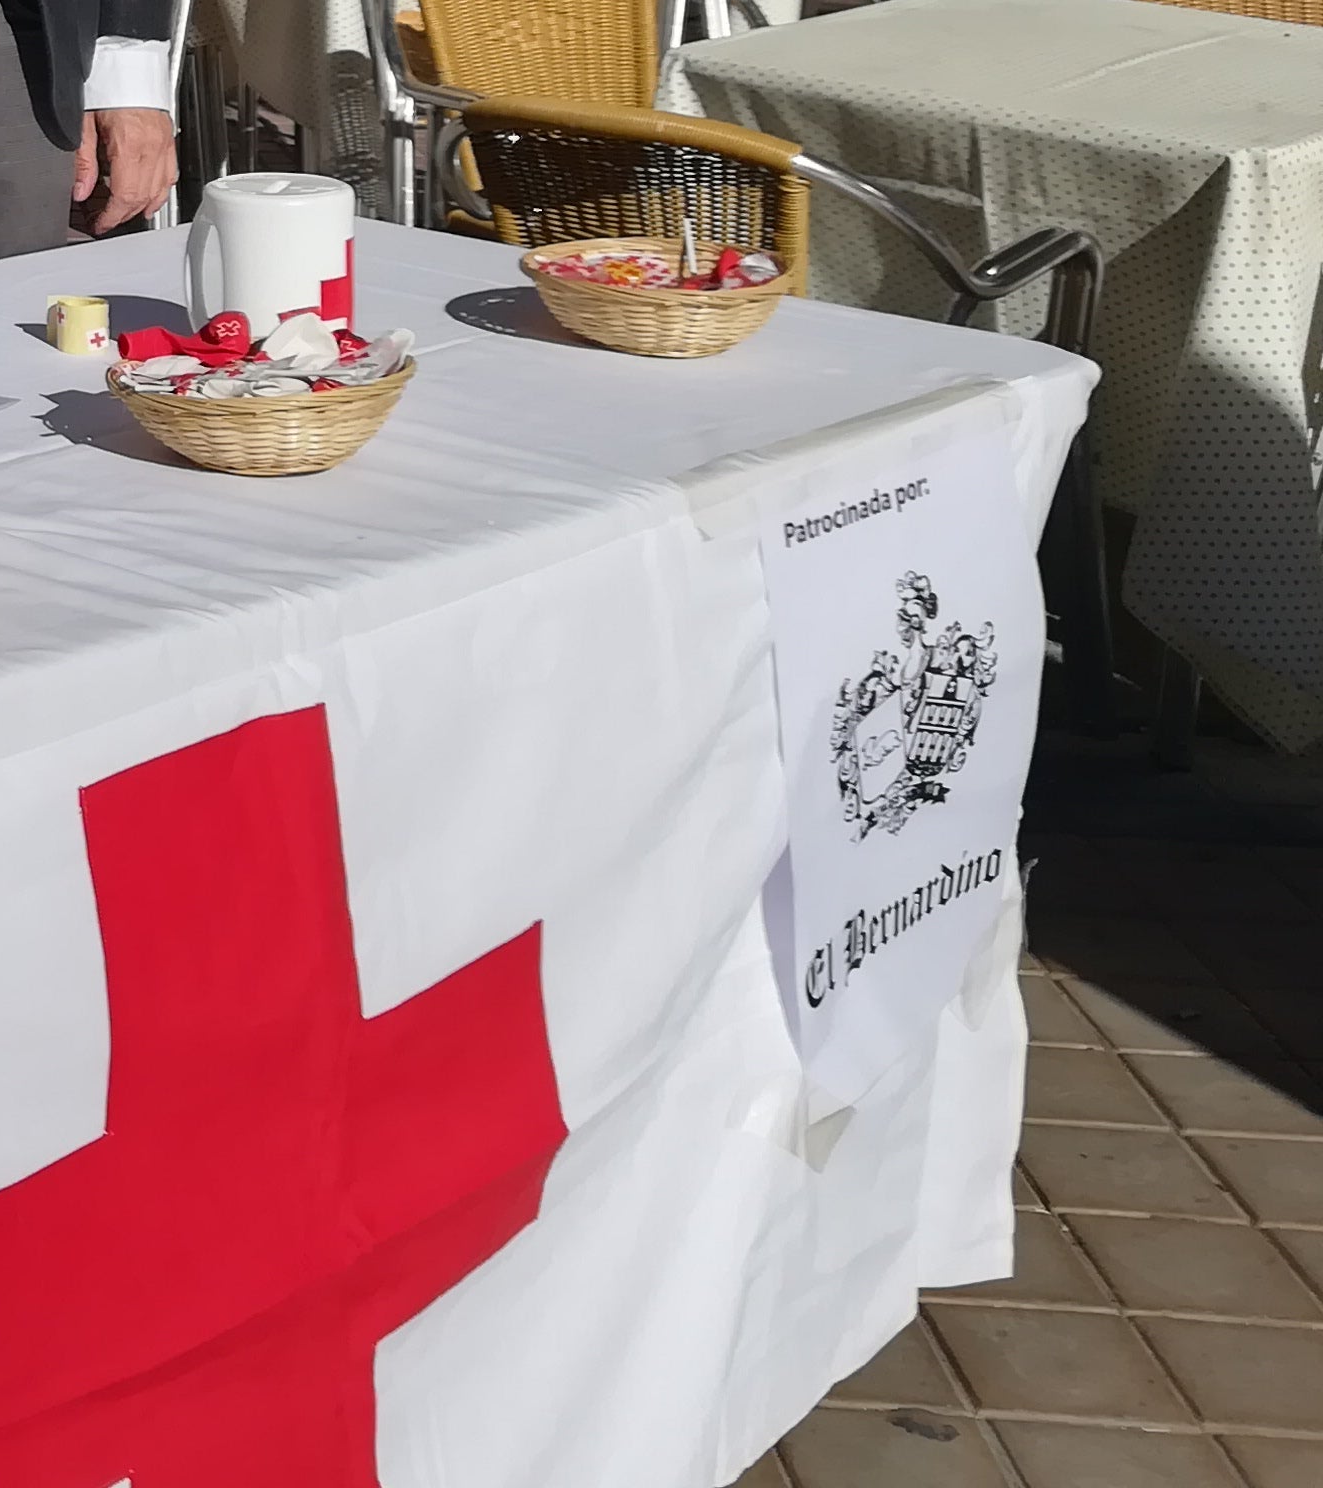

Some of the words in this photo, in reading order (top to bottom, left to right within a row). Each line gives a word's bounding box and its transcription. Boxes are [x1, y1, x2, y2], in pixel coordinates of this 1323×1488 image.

[783, 488, 892, 548] Patrocinada
[806, 938, 835, 1009] El
[844, 849, 1002, 988] Bernardino
